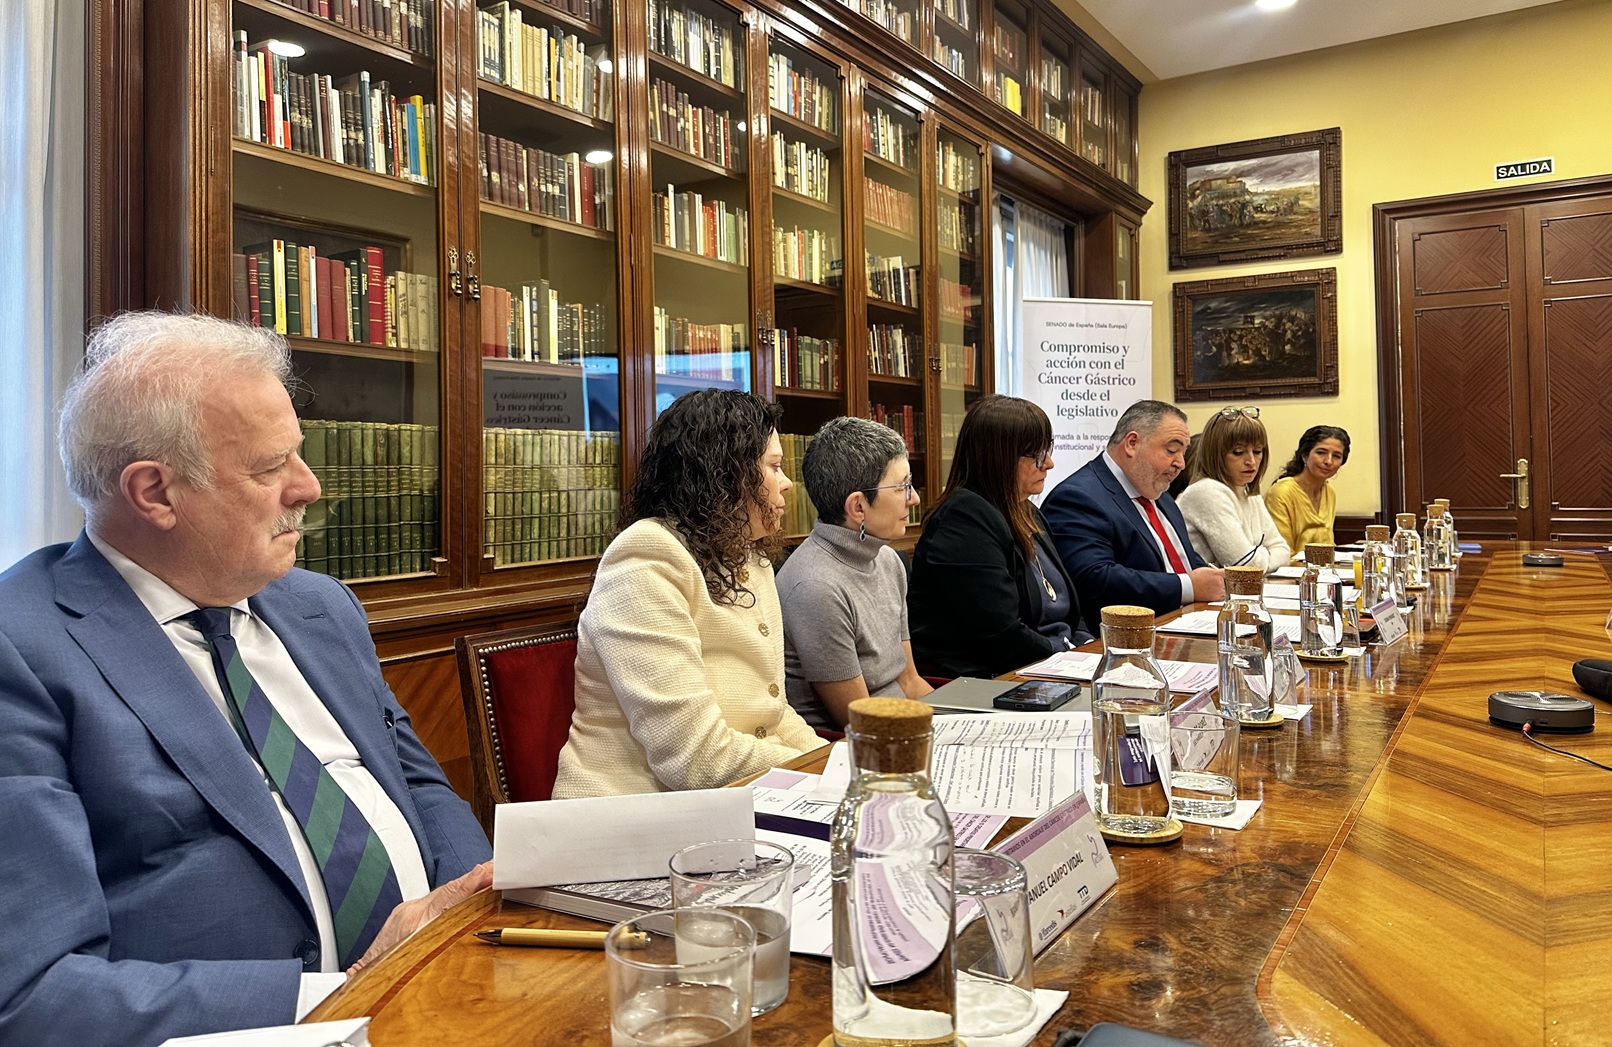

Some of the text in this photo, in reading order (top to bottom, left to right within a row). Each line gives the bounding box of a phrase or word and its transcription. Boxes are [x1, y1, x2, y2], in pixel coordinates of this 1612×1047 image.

[1498, 161, 1551, 178] SALIDA
[1040, 340, 1130, 358] Compromiso y
[1045, 356, 1125, 370] acción con el
[1037, 372, 1136, 386] Cáncer Gástrico
[1060, 389, 1110, 402] desde el
[1056, 404, 1119, 420] legislativo
[1054, 443, 1094, 451] nstitucional
[1028, 880, 1048, 904] ANUEL
[1047, 863, 1068, 888] CAMPO
[1066, 851, 1084, 871] VIDAL
